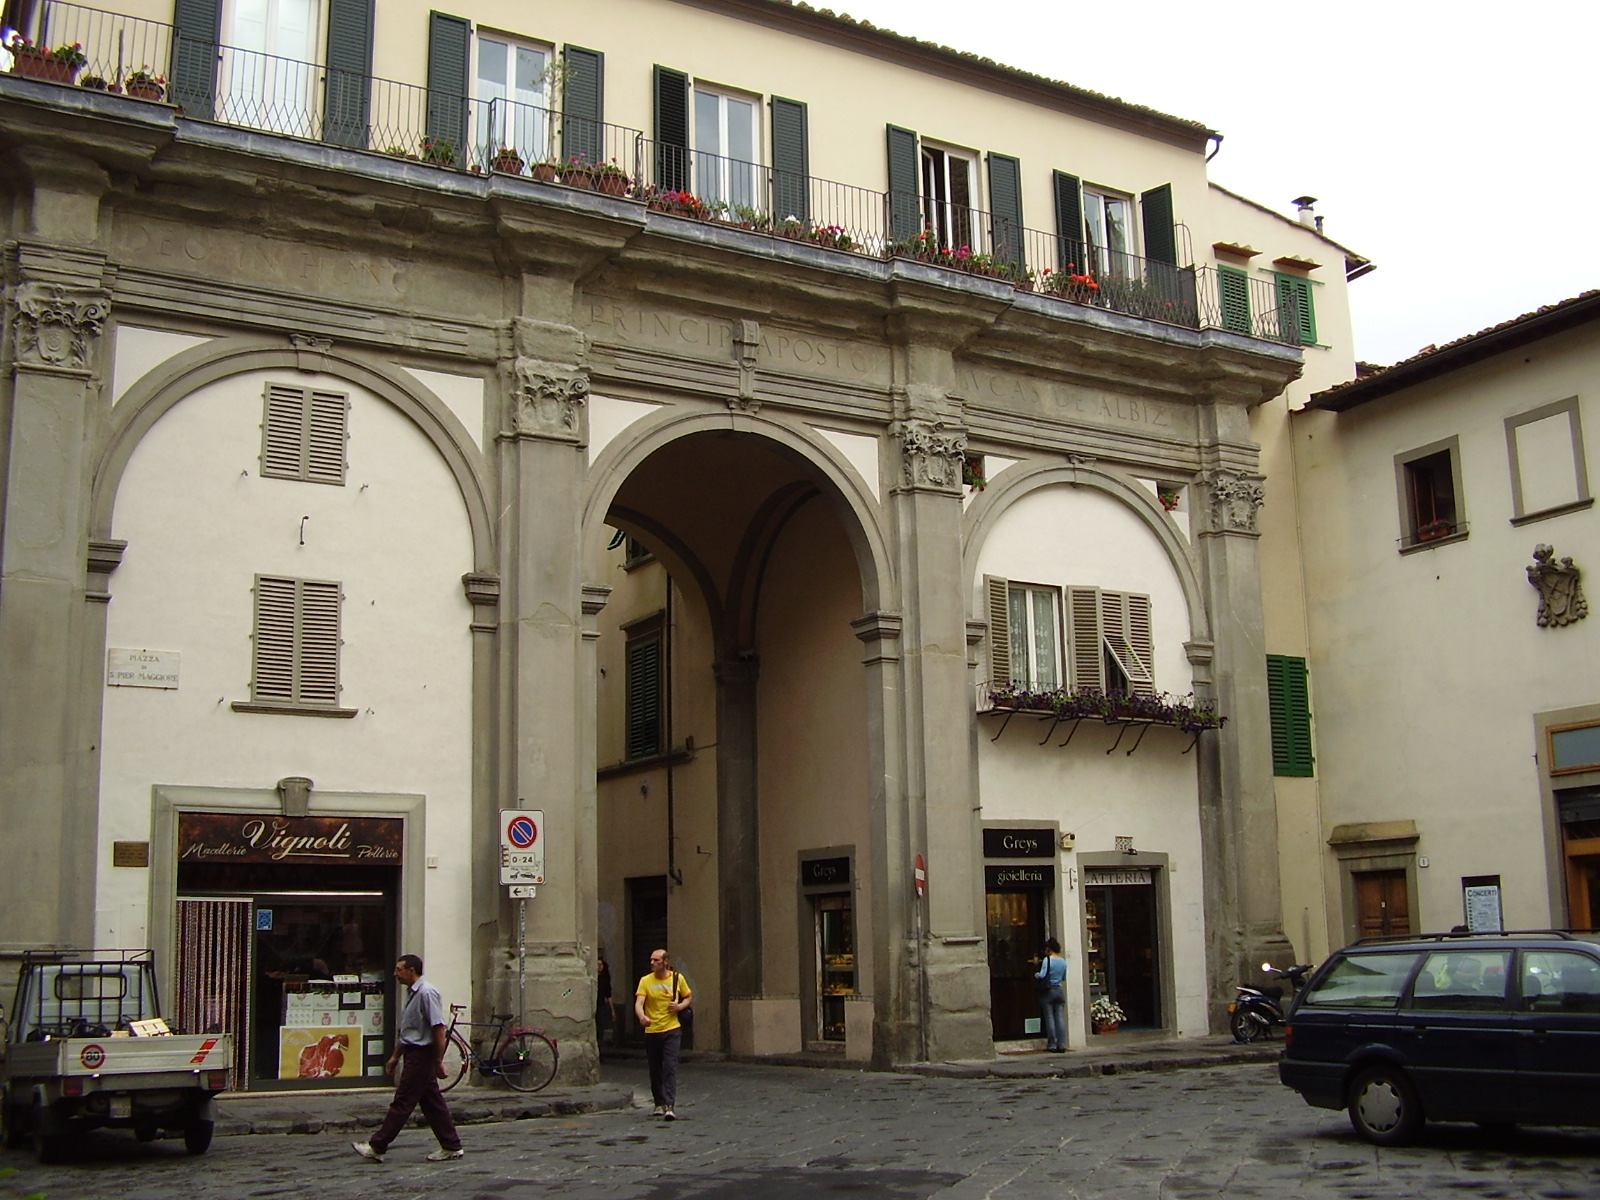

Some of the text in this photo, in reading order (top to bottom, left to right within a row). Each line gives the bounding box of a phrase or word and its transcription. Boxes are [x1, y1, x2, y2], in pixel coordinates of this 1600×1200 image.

[138, 673, 178, 681] MAGGIORE
[242, 820, 351, 860] Vignoli
[1003, 835, 1037, 853] Greys
[814, 864, 837, 880] Greys
[997, 869, 1042, 885] gioielleria
